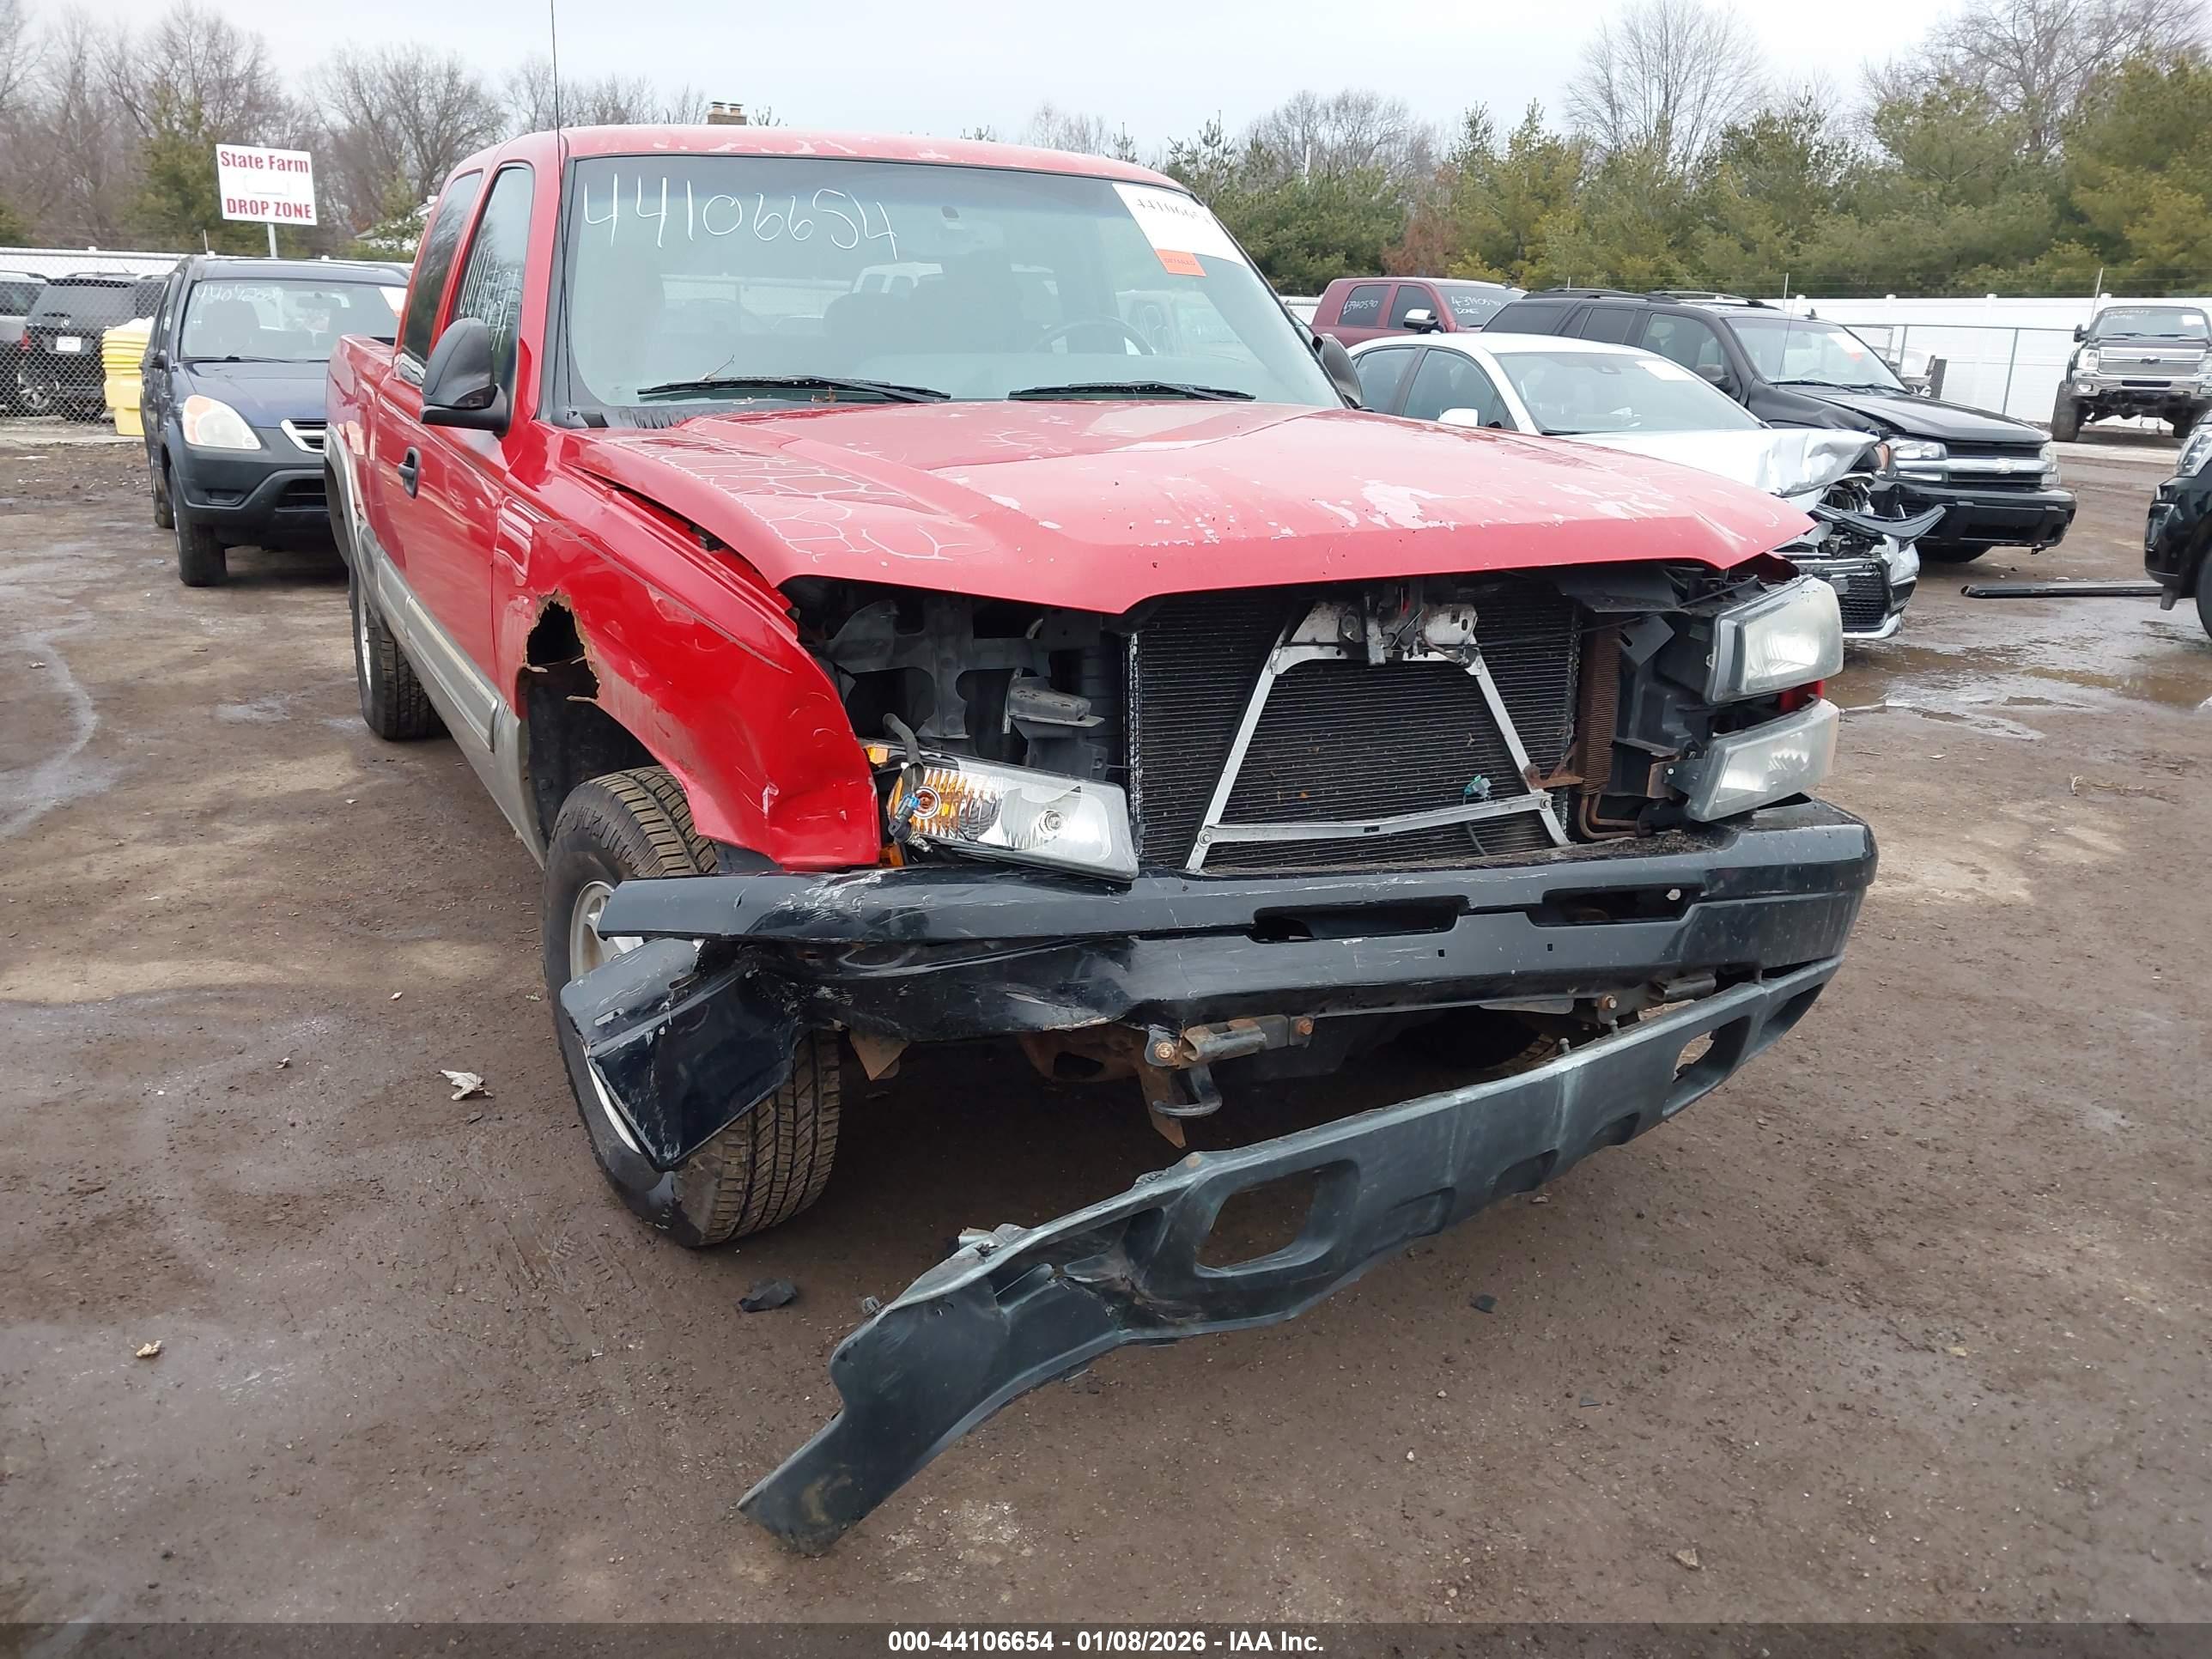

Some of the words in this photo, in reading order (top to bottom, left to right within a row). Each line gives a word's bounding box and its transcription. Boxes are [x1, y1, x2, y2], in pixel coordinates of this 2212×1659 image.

[220, 150, 264, 170] State
[268, 155, 309, 173] Farm
[226, 198, 270, 216] DROP
[273, 201, 313, 220] ZONE
[583, 173, 898, 261] 44106654
